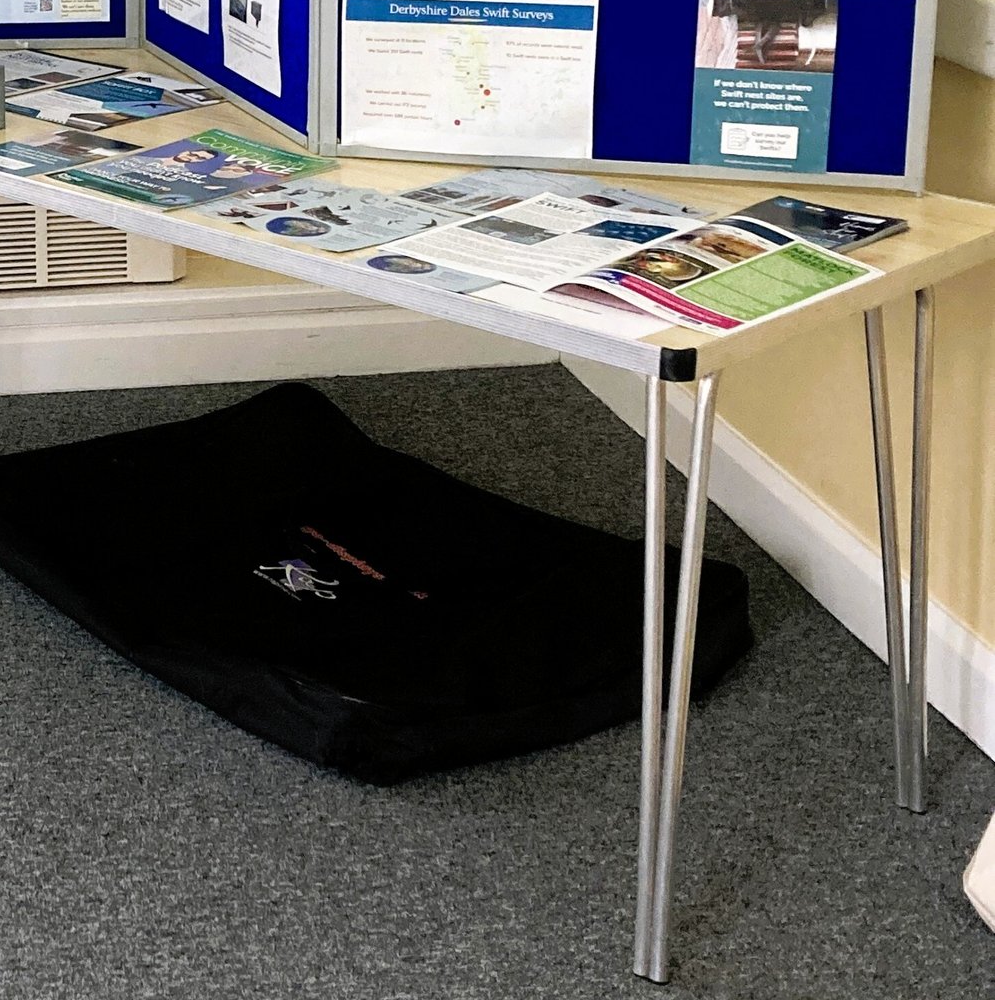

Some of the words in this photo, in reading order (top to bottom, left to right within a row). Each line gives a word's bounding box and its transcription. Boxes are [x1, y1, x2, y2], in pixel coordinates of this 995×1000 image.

[389, 3, 448, 17] Derbyshire
[450, 6, 481, 17] Dales
[483, 7, 509, 18] Swift
[512, 9, 554, 22] Surveys
[714, 79, 721, 87] If
[735, 80, 758, 89] don't
[759, 81, 784, 90] know
[784, 83, 812, 92] where
[721, 89, 743, 98] Swift
[765, 92, 786, 100] sites
[728, 100, 750, 108] can't
[751, 102, 783, 110] protect
[784, 103, 809, 112] them.
[224, 154, 303, 175] VOICE
